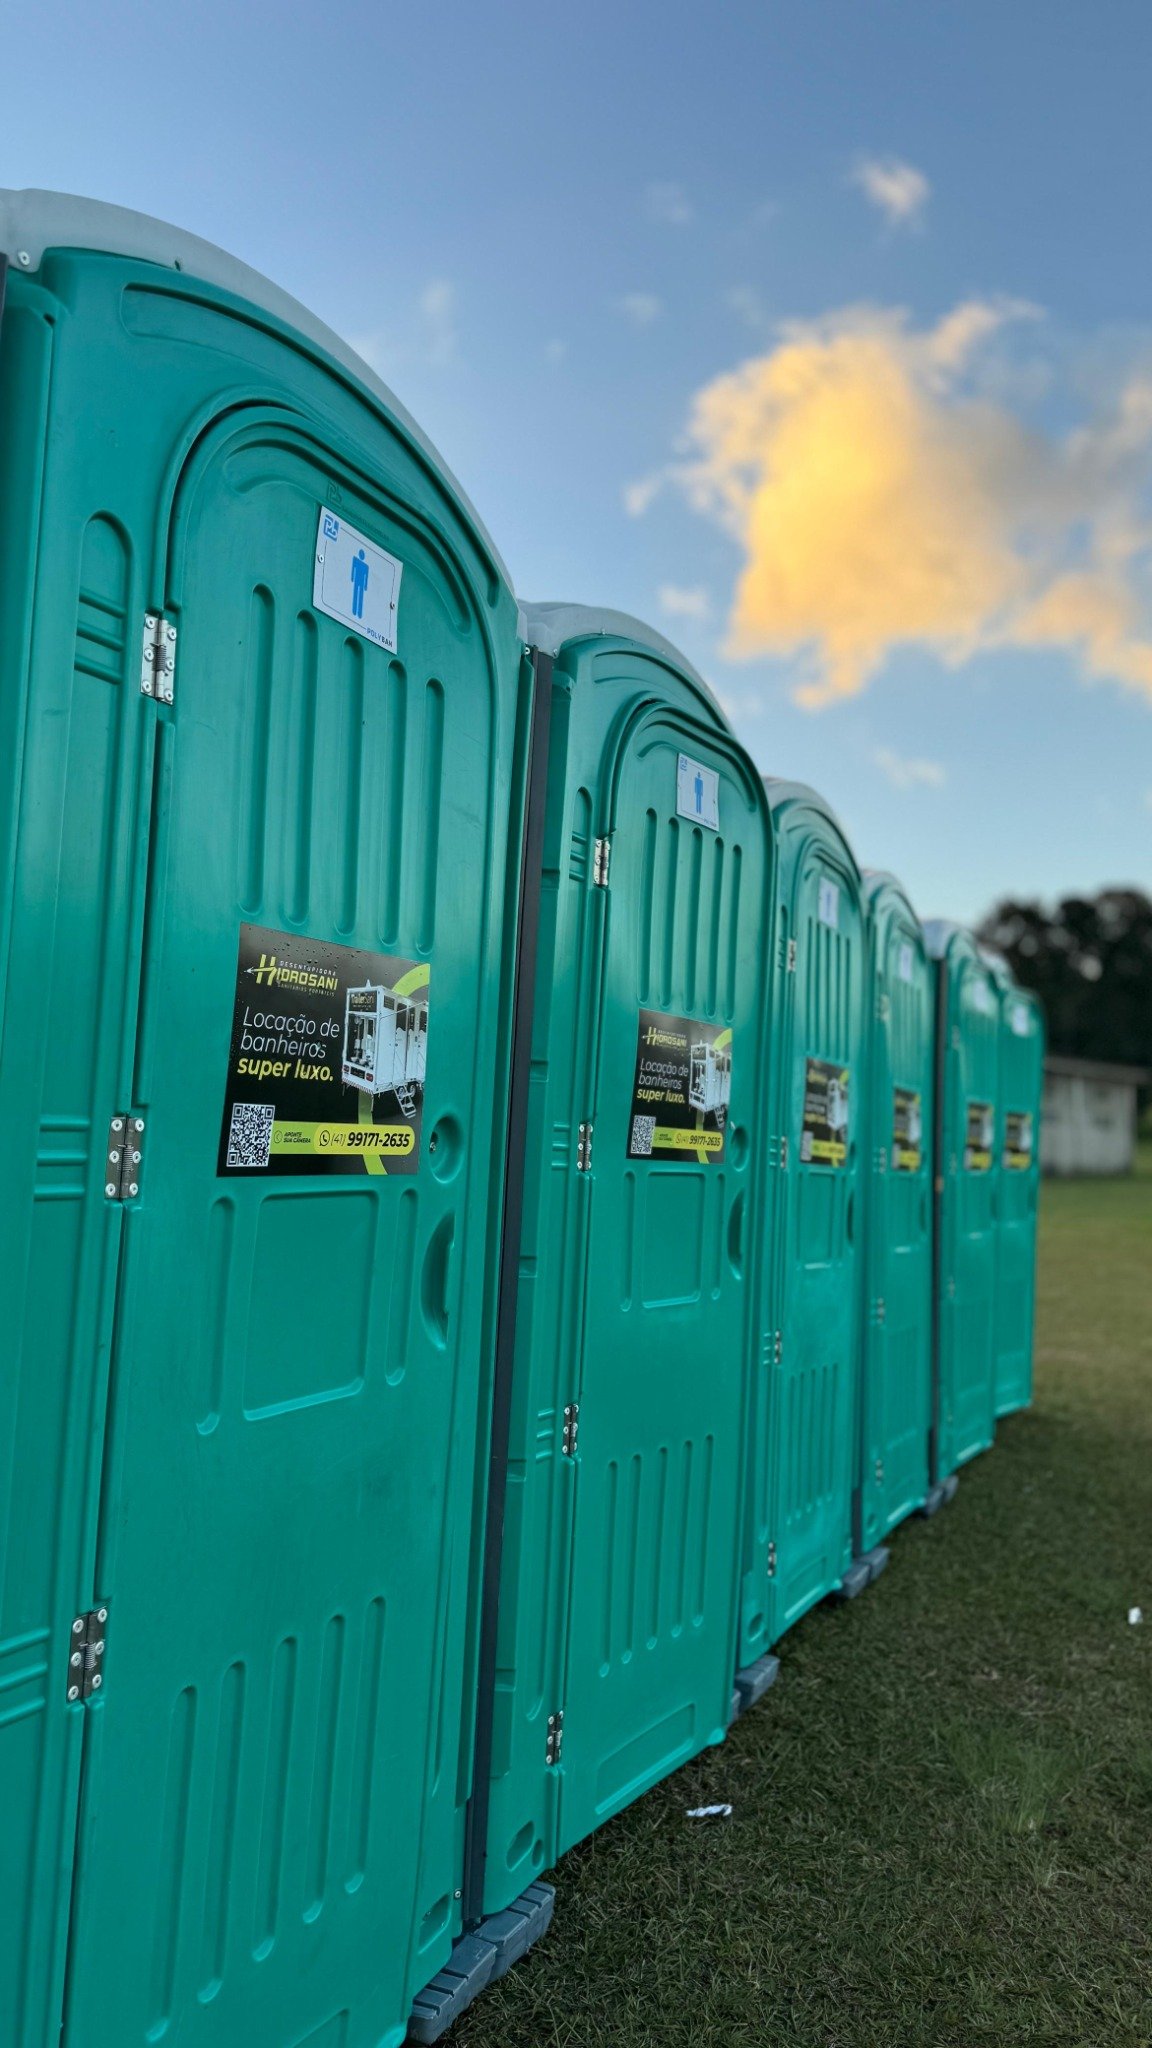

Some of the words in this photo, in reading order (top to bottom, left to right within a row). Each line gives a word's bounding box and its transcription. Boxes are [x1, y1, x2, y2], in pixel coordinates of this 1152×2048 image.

[255, 954, 338, 991] HIDROSANI
[243, 1006, 316, 1037] Locação
[320, 1018, 340, 1038] de
[241, 1029, 327, 1059] banheiros
[237, 1058, 292, 1080] super
[294, 1059, 334, 1081] luxo.
[640, 1058, 677, 1076] Locação
[678, 1064, 689, 1077] de
[638, 1071, 682, 1090] banheiros
[636, 1088, 665, 1103] super
[665, 1089, 686, 1104] luxo.
[330, 1133, 347, 1147] (41)
[347, 1132, 411, 1148] 99171-2635
[689, 1134, 721, 1147] 99171-2635
